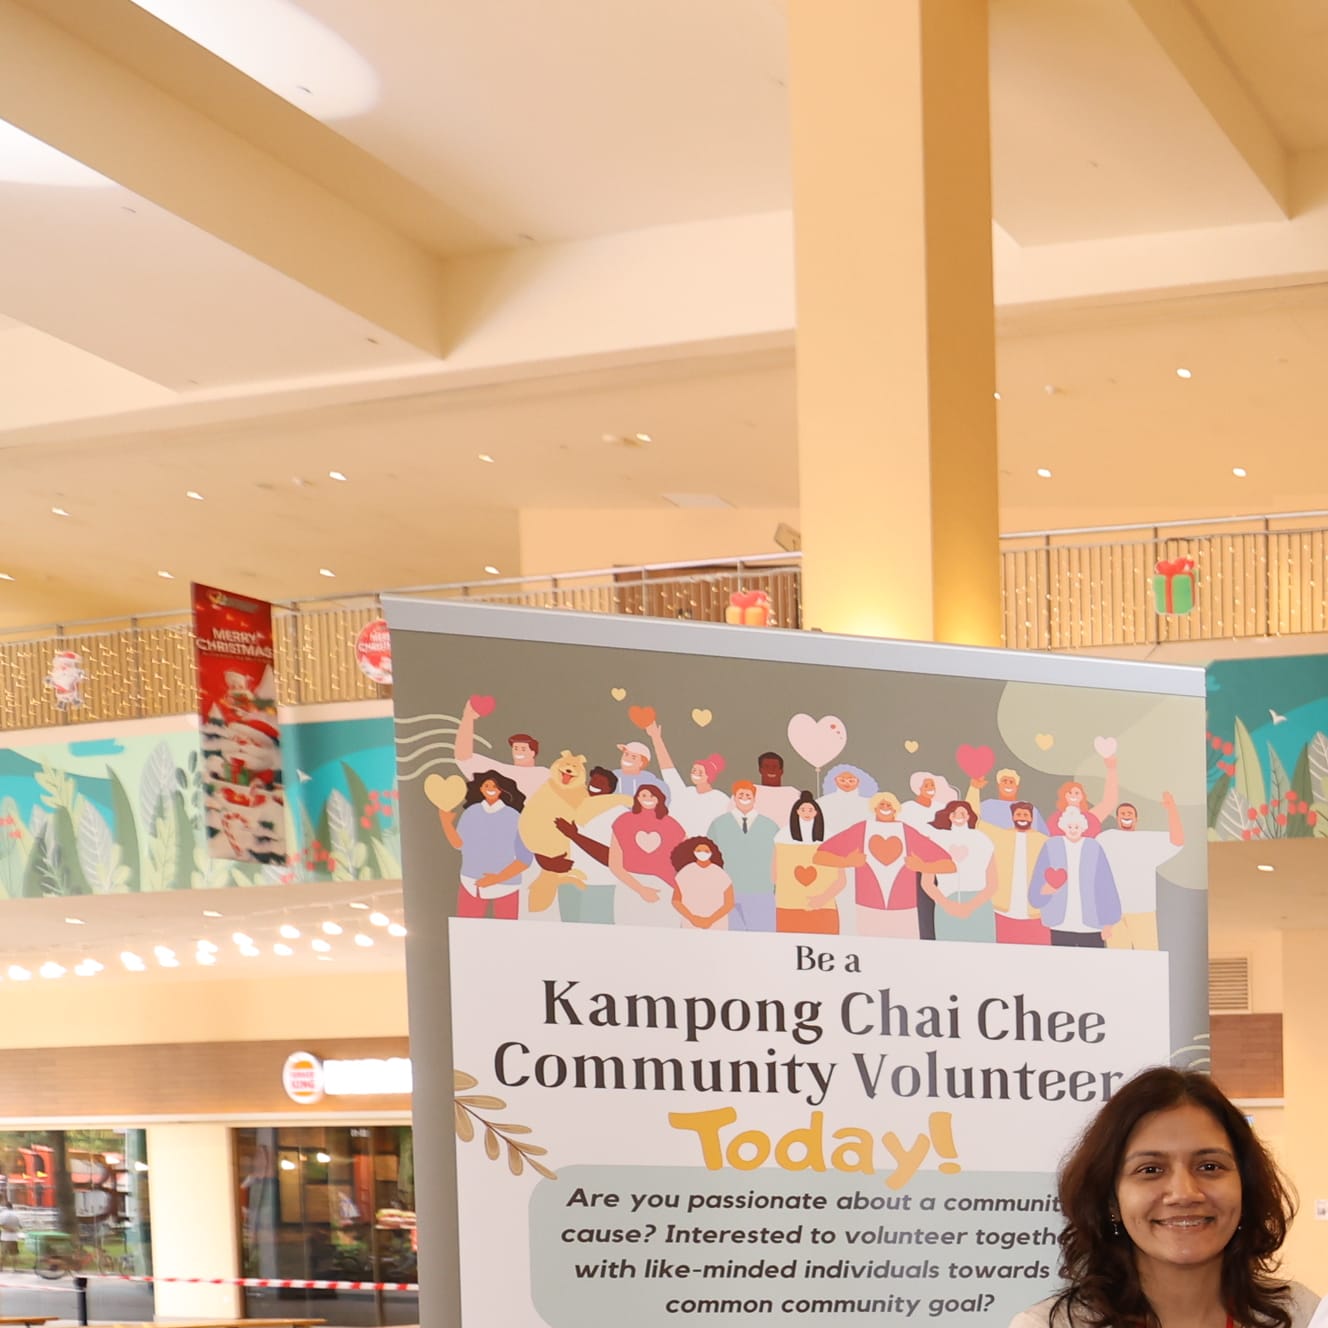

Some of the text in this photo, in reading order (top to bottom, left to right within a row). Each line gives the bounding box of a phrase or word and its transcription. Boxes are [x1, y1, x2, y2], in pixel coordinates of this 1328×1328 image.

[212, 627, 257, 643] MERRY
[195, 639, 274, 659] CHRISTMAS
[795, 945, 862, 973] Be a
[542, 979, 1107, 1045] Kampong Chai Chee
[493, 1041, 1125, 1106] Community Volunteer
[667, 1106, 962, 1190] Today!
[566, 1188, 1062, 1215] Are you passionate about a communit
[561, 1225, 657, 1246] cause?
[665, 1223, 802, 1246] Interested
[810, 1227, 837, 1246] to
[845, 1226, 969, 1247] volunteer
[574, 1259, 1051, 1281] with like-minded individuals towards
[665, 1293, 996, 1318] common community goal?
